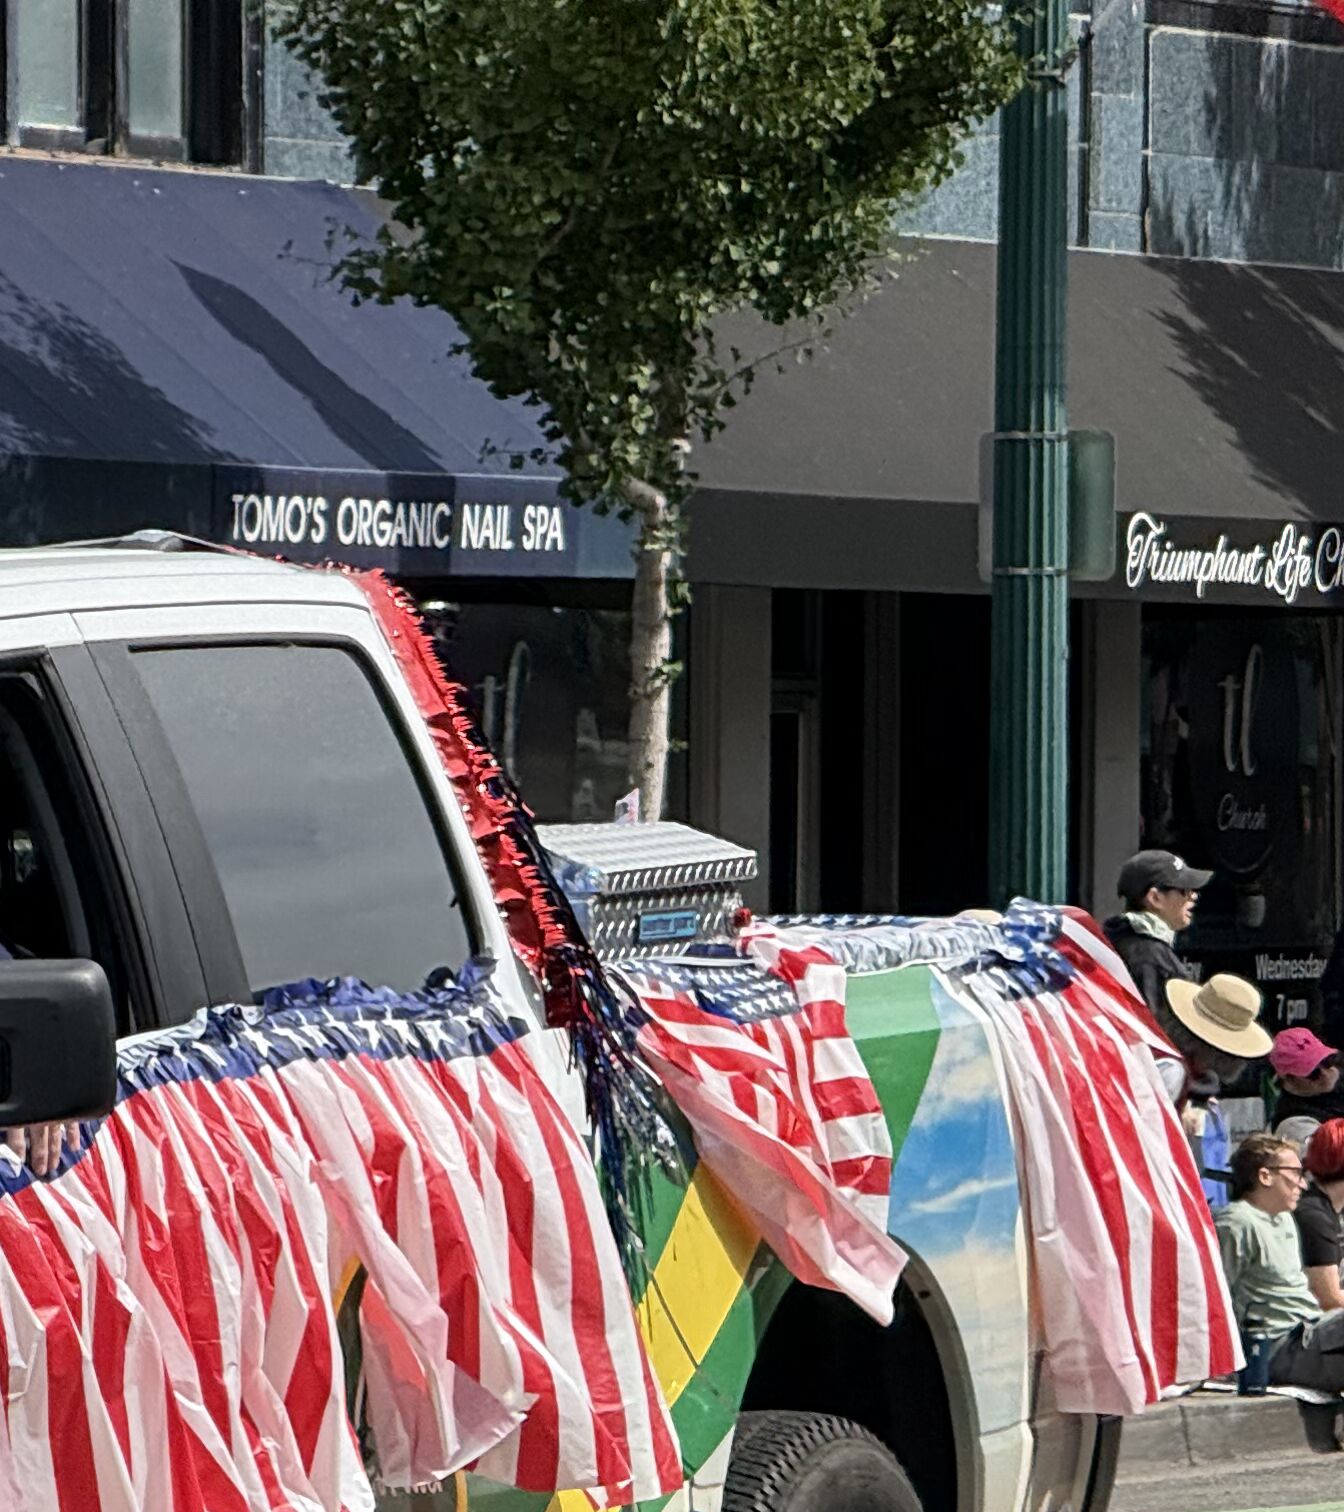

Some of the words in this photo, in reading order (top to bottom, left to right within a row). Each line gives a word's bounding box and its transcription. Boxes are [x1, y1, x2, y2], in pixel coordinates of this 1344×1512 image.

[231, 494, 328, 543] TOMO'S
[336, 498, 452, 549] ORGANIC
[461, 504, 514, 550] NAIL
[521, 504, 564, 551] SPA
[1126, 512, 1266, 599] Triumphant
[1264, 523, 1313, 604] Life
[1255, 953, 1328, 981] Wednesday
[1276, 993, 1285, 1020] 7
[1286, 998, 1308, 1026] pm
